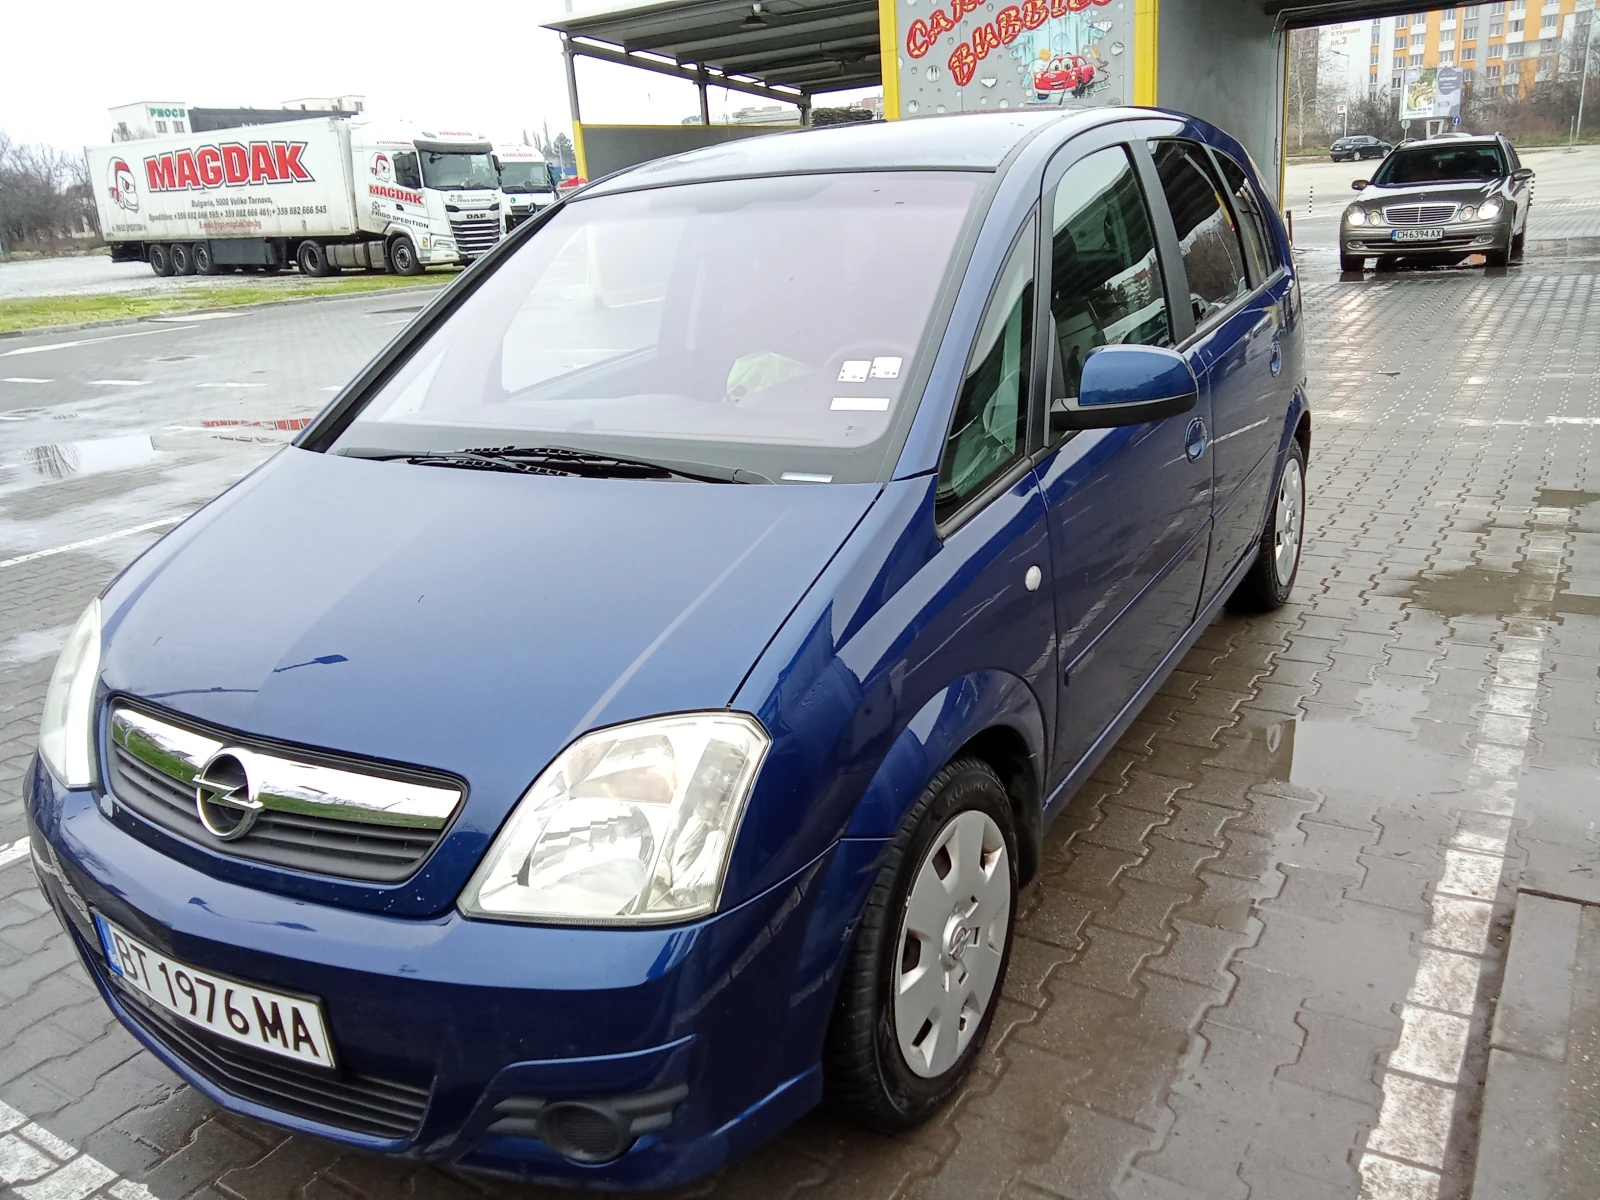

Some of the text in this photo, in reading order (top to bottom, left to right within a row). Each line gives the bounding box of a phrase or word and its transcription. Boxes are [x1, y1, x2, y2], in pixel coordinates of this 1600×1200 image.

[907, 0, 987, 58] CAR
[948, 0, 1112, 86] BUBBL
[144, 141, 315, 193] MAGDAK
[230, 197, 248, 205] Veliko
[248, 196, 273, 204] Tarnovo,
[368, 184, 424, 206] MAGDAK
[277, 207, 288, 215] 359
[302, 206, 314, 214] 666
[315, 205, 327, 213] 545
[371, 211, 429, 229] FRIGO SPEDITION
[1430, 230, 1441, 238] AX
[113, 932, 320, 1058] BT 1976 MA
